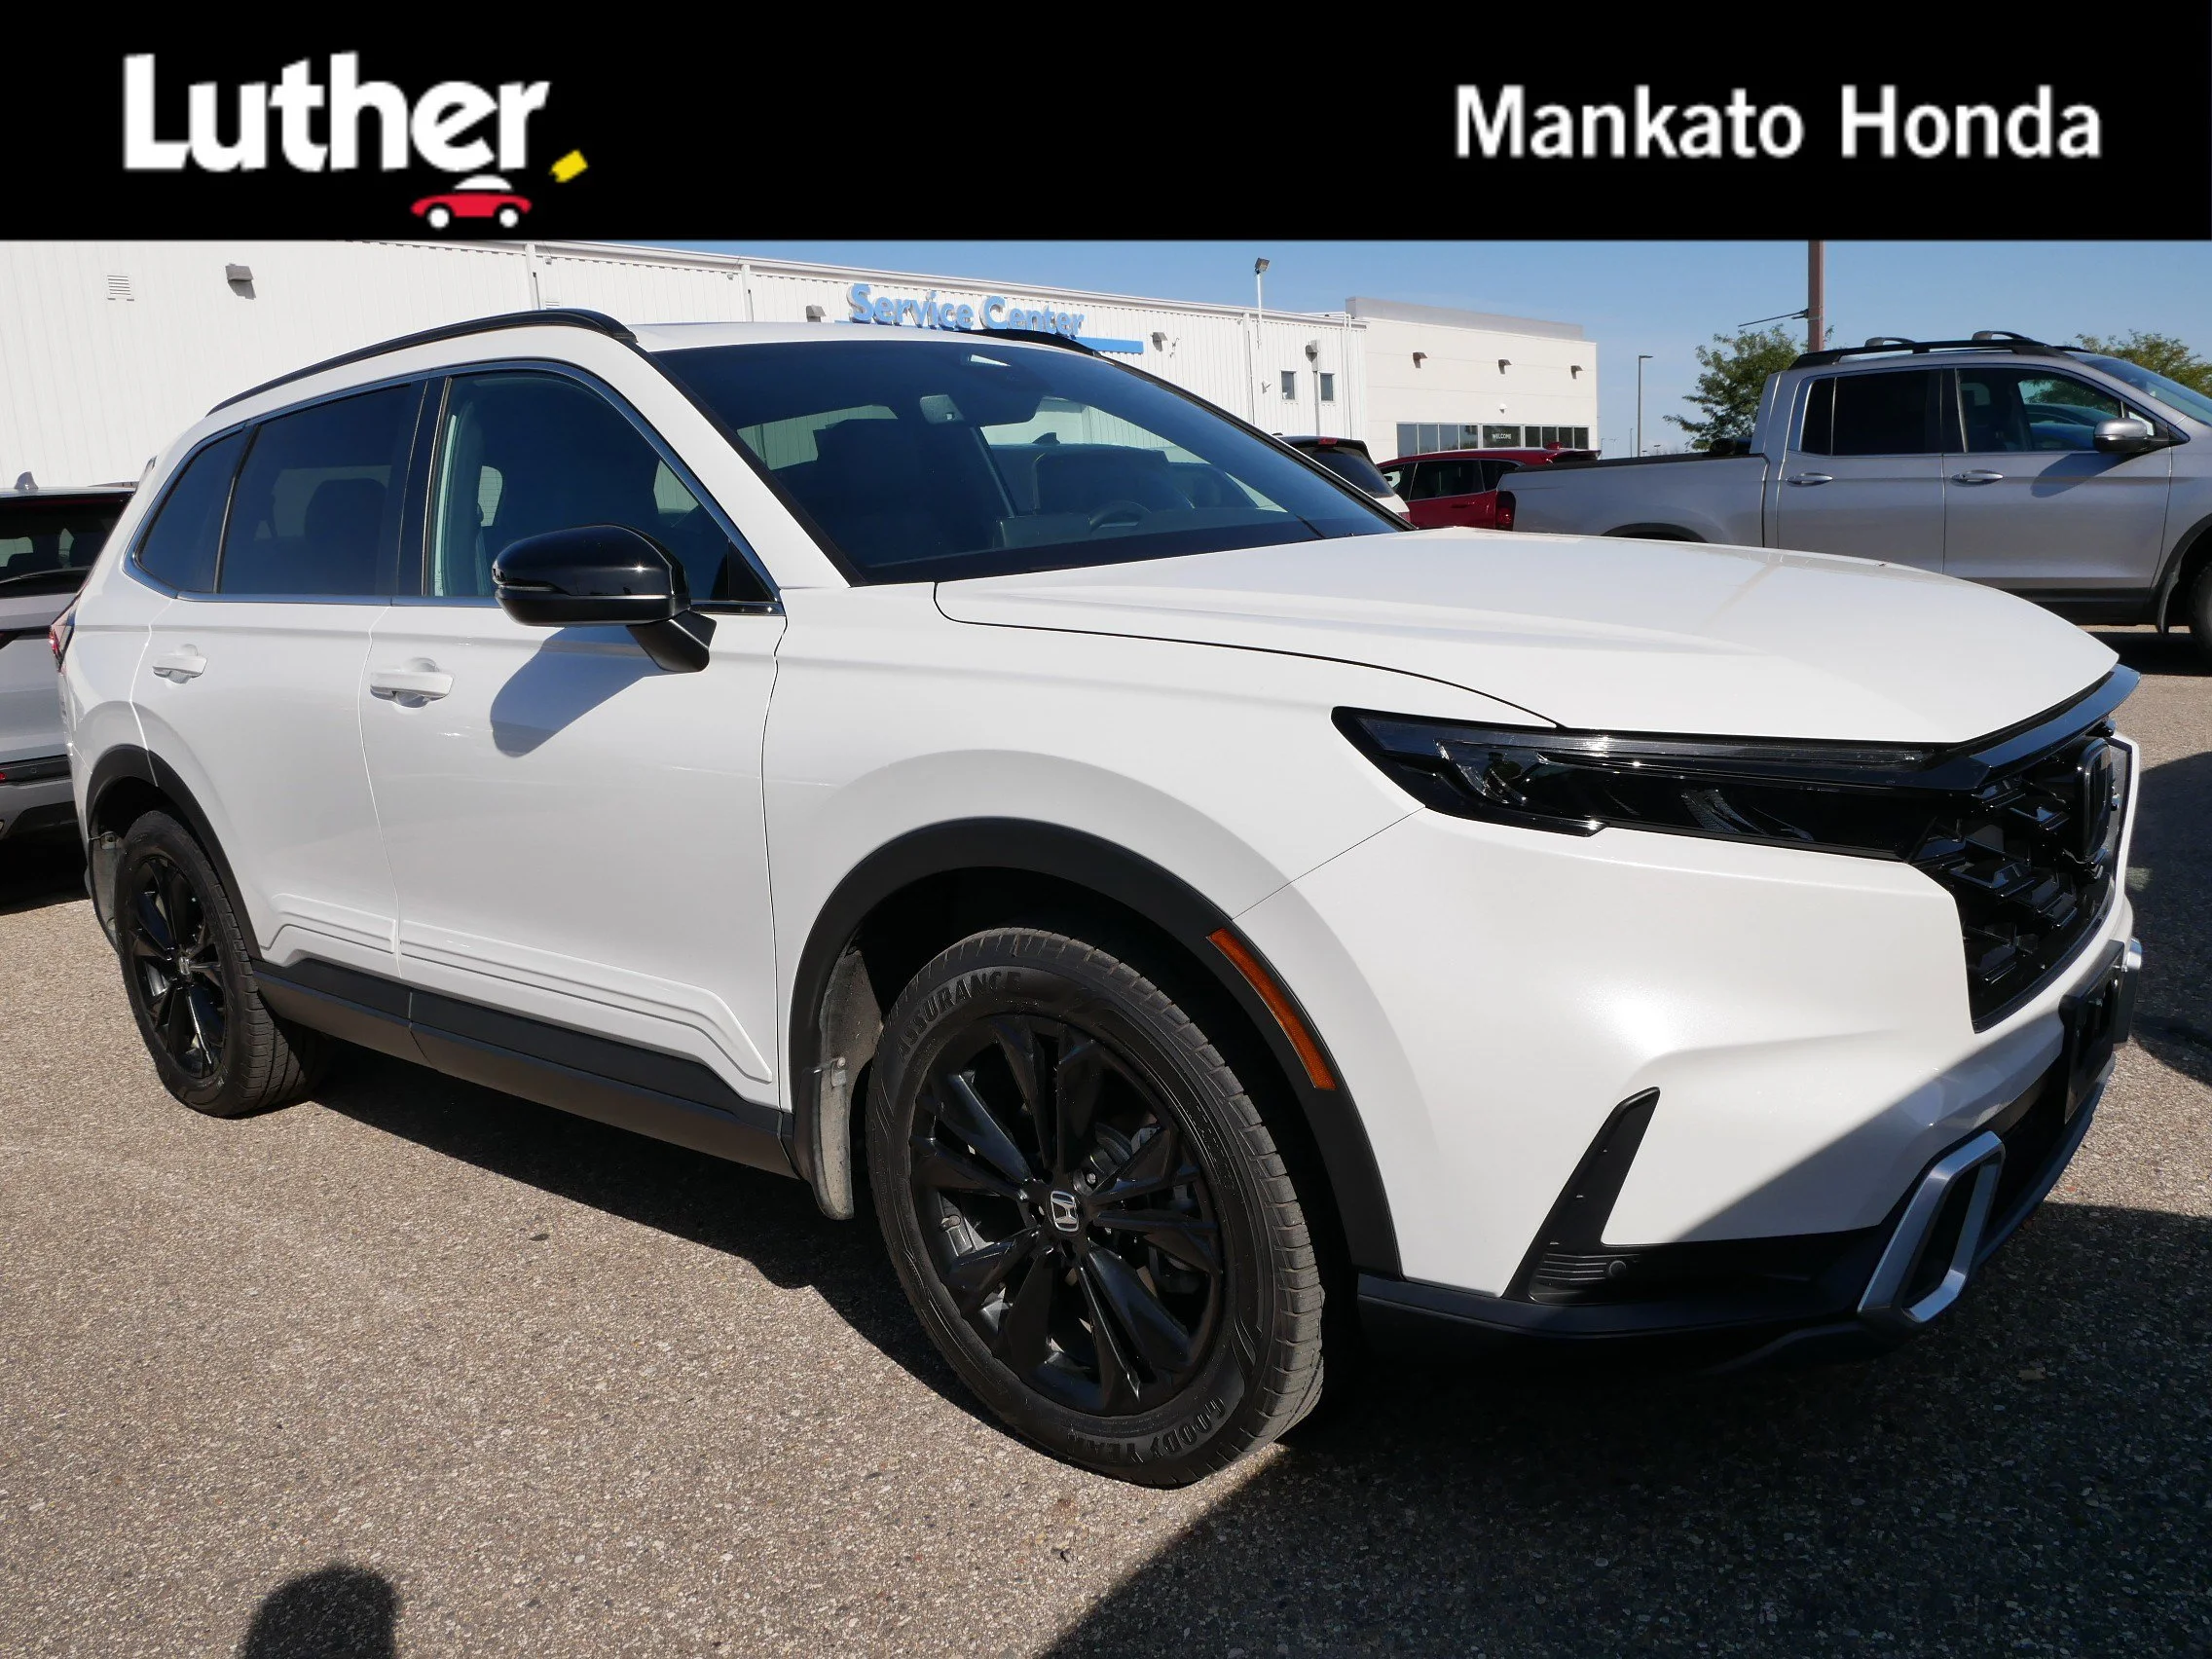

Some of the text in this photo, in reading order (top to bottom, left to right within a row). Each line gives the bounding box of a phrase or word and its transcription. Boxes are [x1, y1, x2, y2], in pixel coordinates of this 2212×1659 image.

[847, 282, 1085, 340] Service Center
[896, 971, 1022, 1061] ASSURANCE
